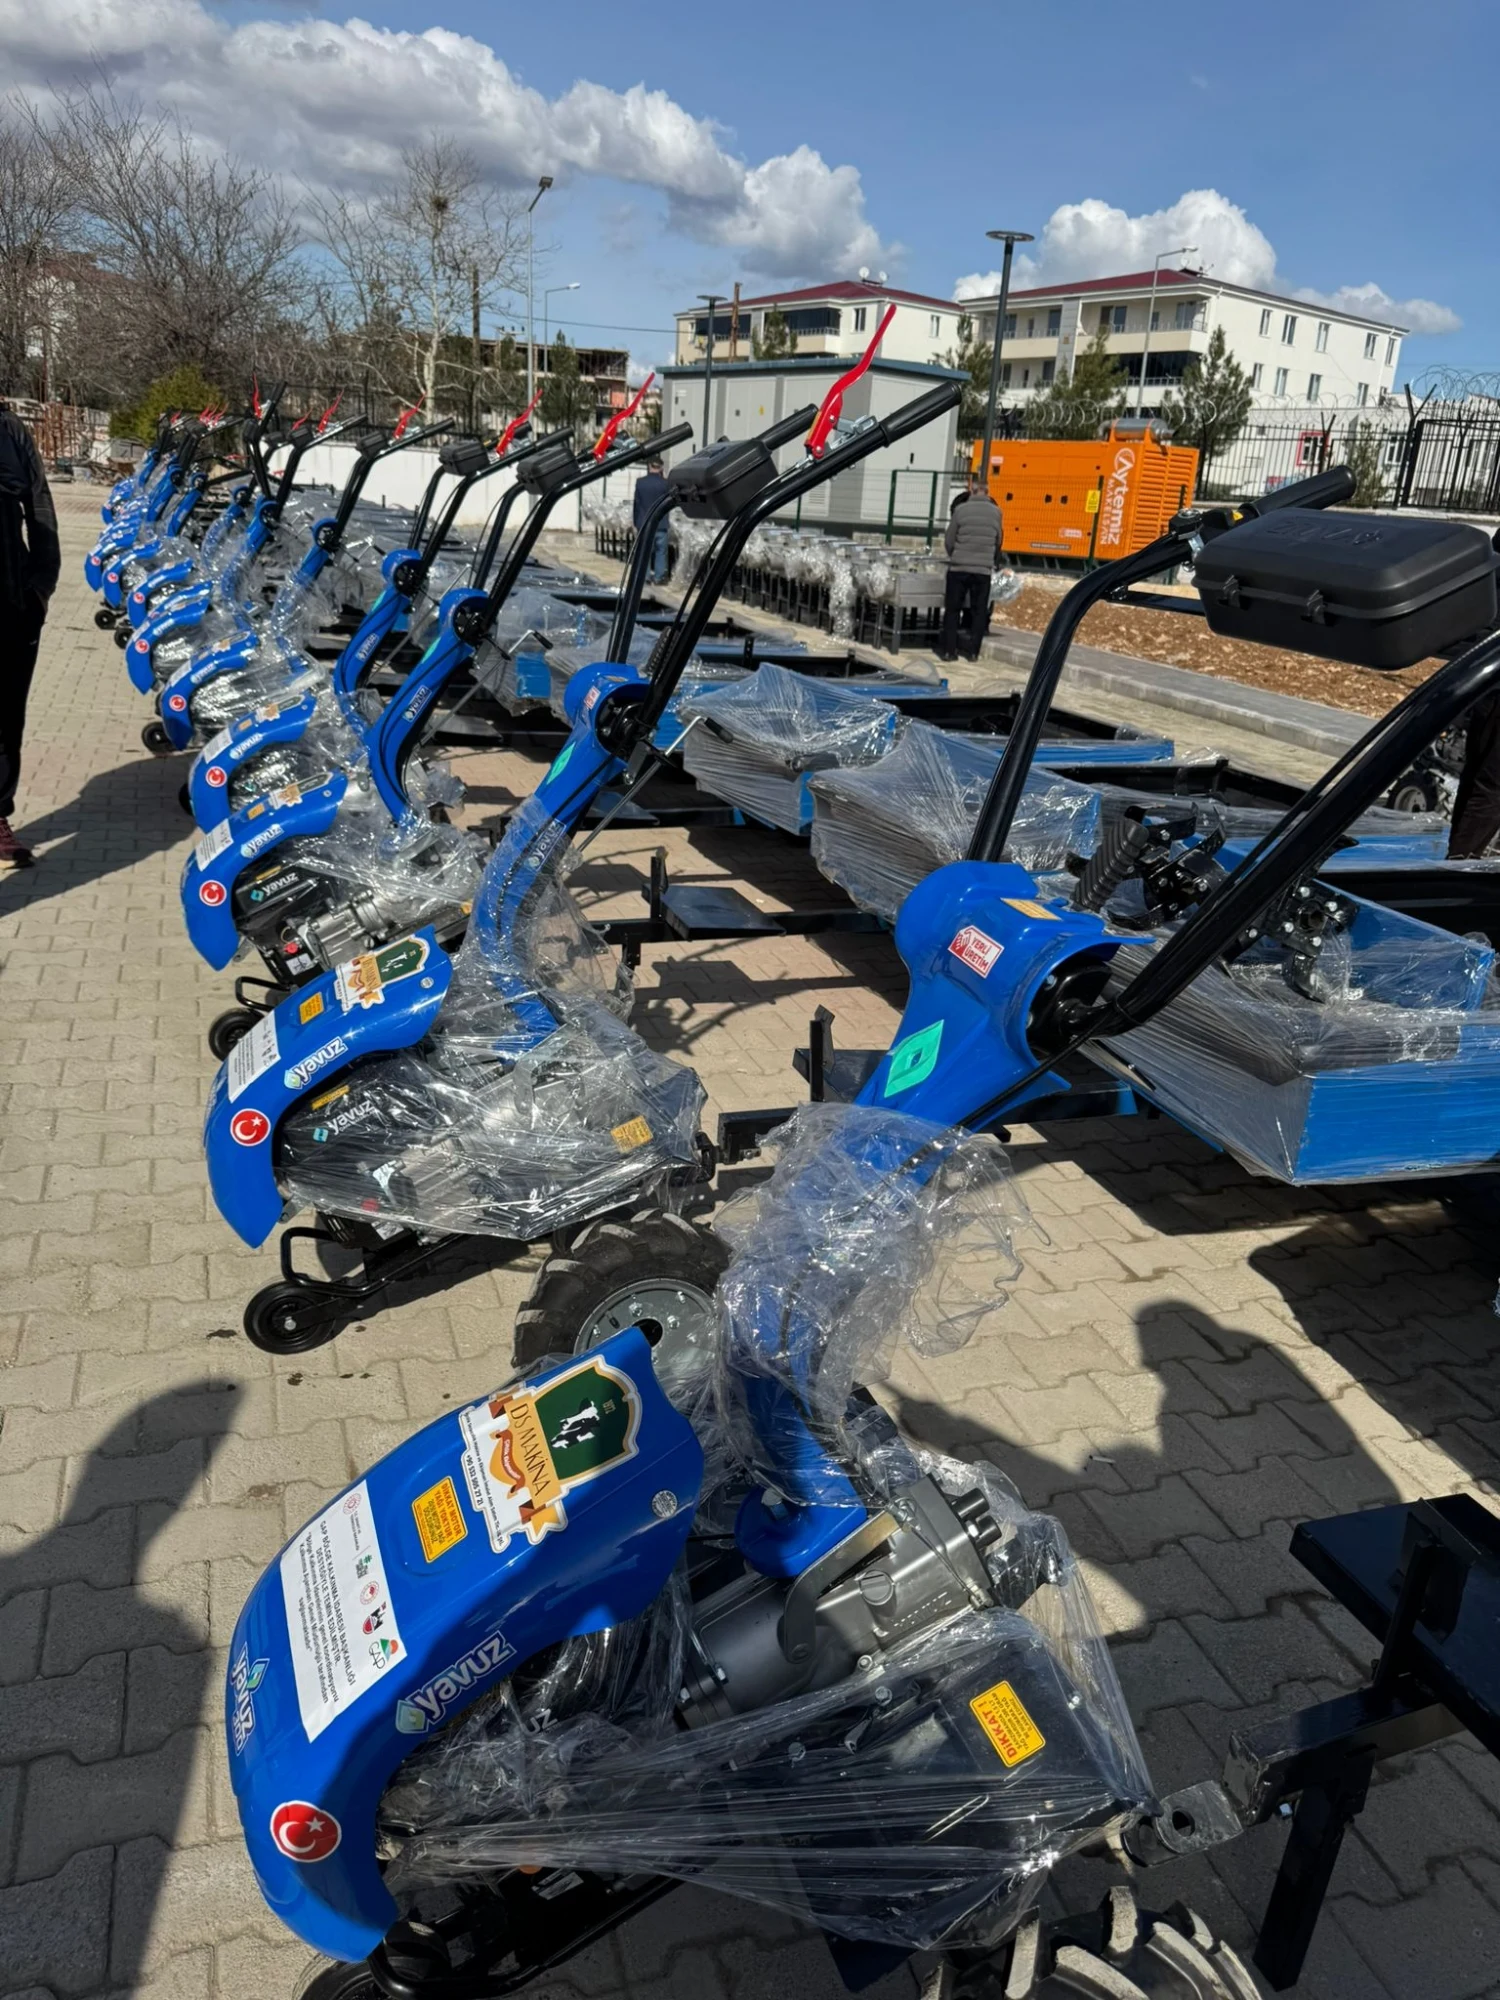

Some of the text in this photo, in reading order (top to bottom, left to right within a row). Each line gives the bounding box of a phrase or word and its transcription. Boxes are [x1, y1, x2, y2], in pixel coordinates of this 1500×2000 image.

[1100, 479, 1115, 545] MAKELSAN
[247, 825, 280, 852] yavuz
[532, 820, 560, 859] yavuz
[261, 871, 297, 896] yavuz
[964, 945, 988, 969] ÜRETİM
[293, 1038, 344, 1082] yavuz
[323, 1099, 374, 1135] yavuz
[510, 1403, 551, 1497] DS MAKİNA
[448, 1508, 462, 1536] MOTOR
[326, 1559, 339, 1601] KALKINMA
[323, 1591, 333, 1618] TEMİN
[332, 1597, 345, 1634] İDARESİ
[338, 1630, 356, 1688] BAŞKANLIĞI
[369, 1641, 386, 1670] GAP
[231, 1650, 253, 1739] yavuz
[412, 1637, 510, 1720] yavuz
